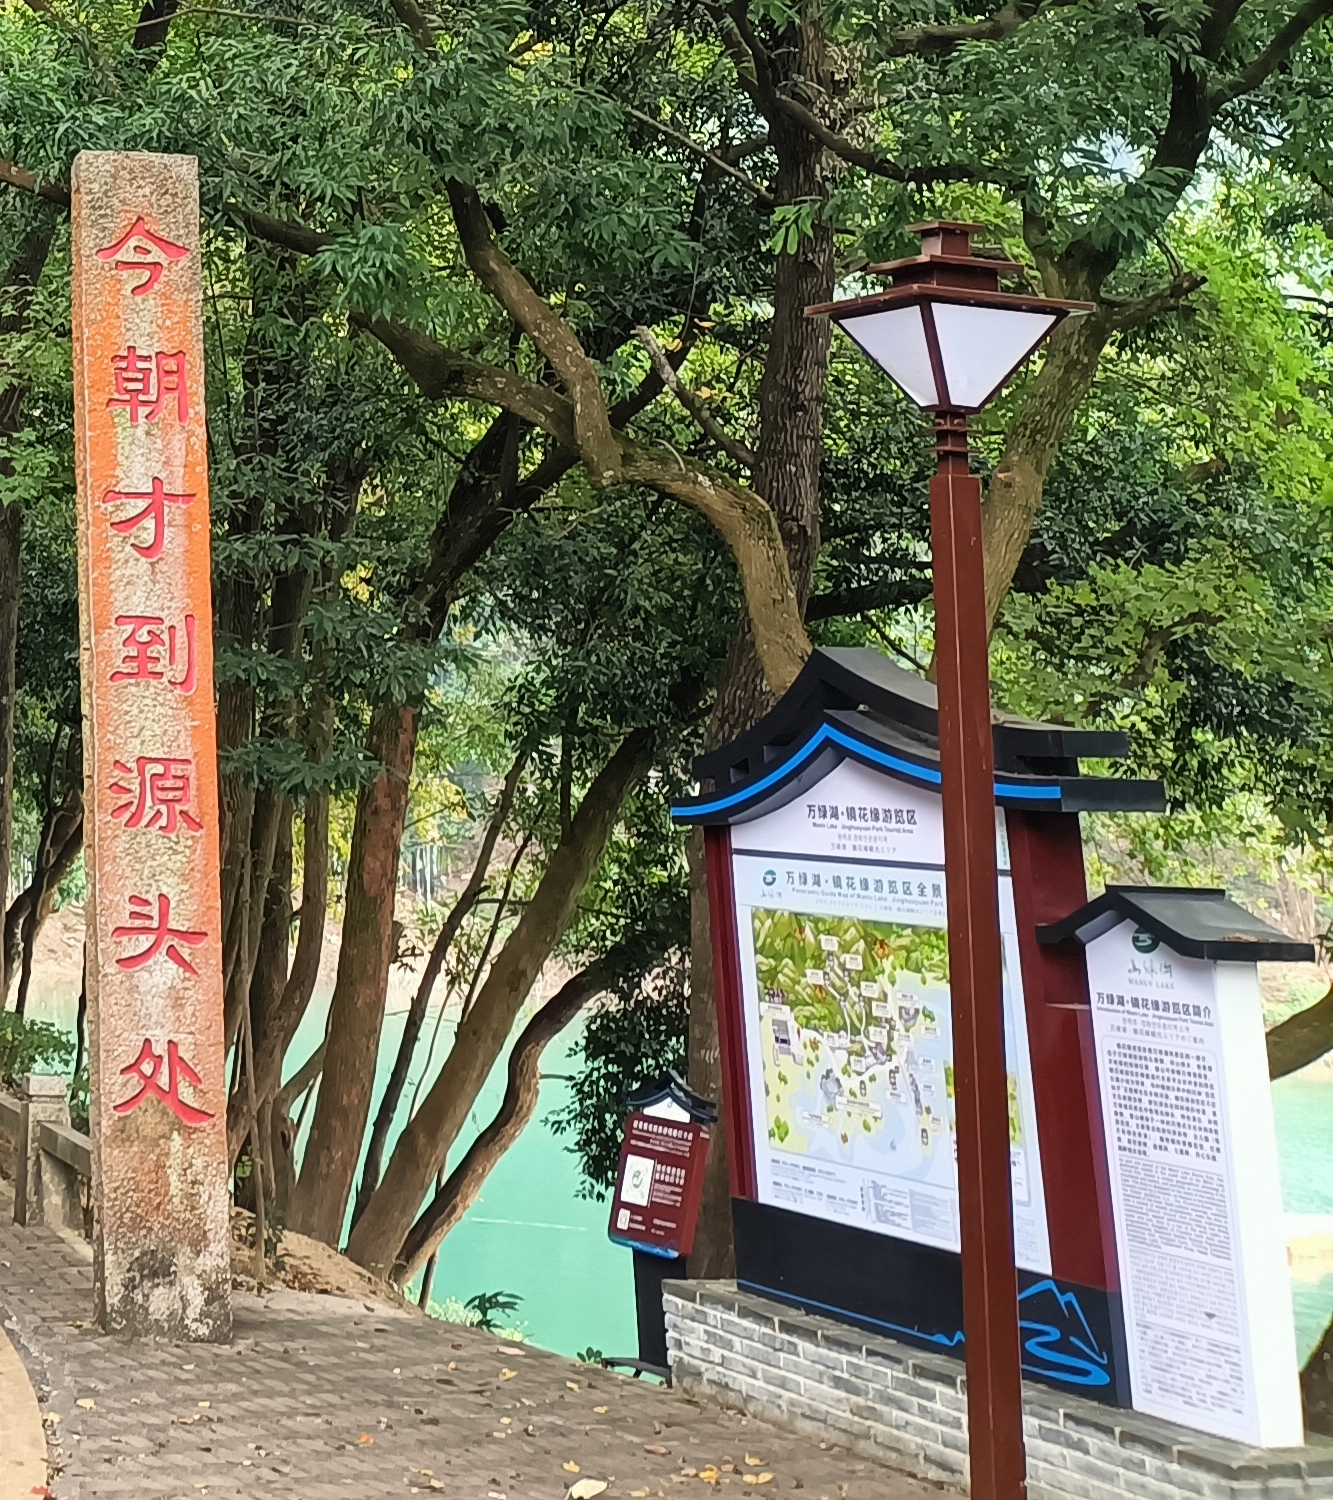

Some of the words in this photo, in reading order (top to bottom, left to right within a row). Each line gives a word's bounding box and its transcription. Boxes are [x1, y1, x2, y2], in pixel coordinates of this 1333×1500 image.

[95, 214, 216, 1124] 今朝才到源头处
